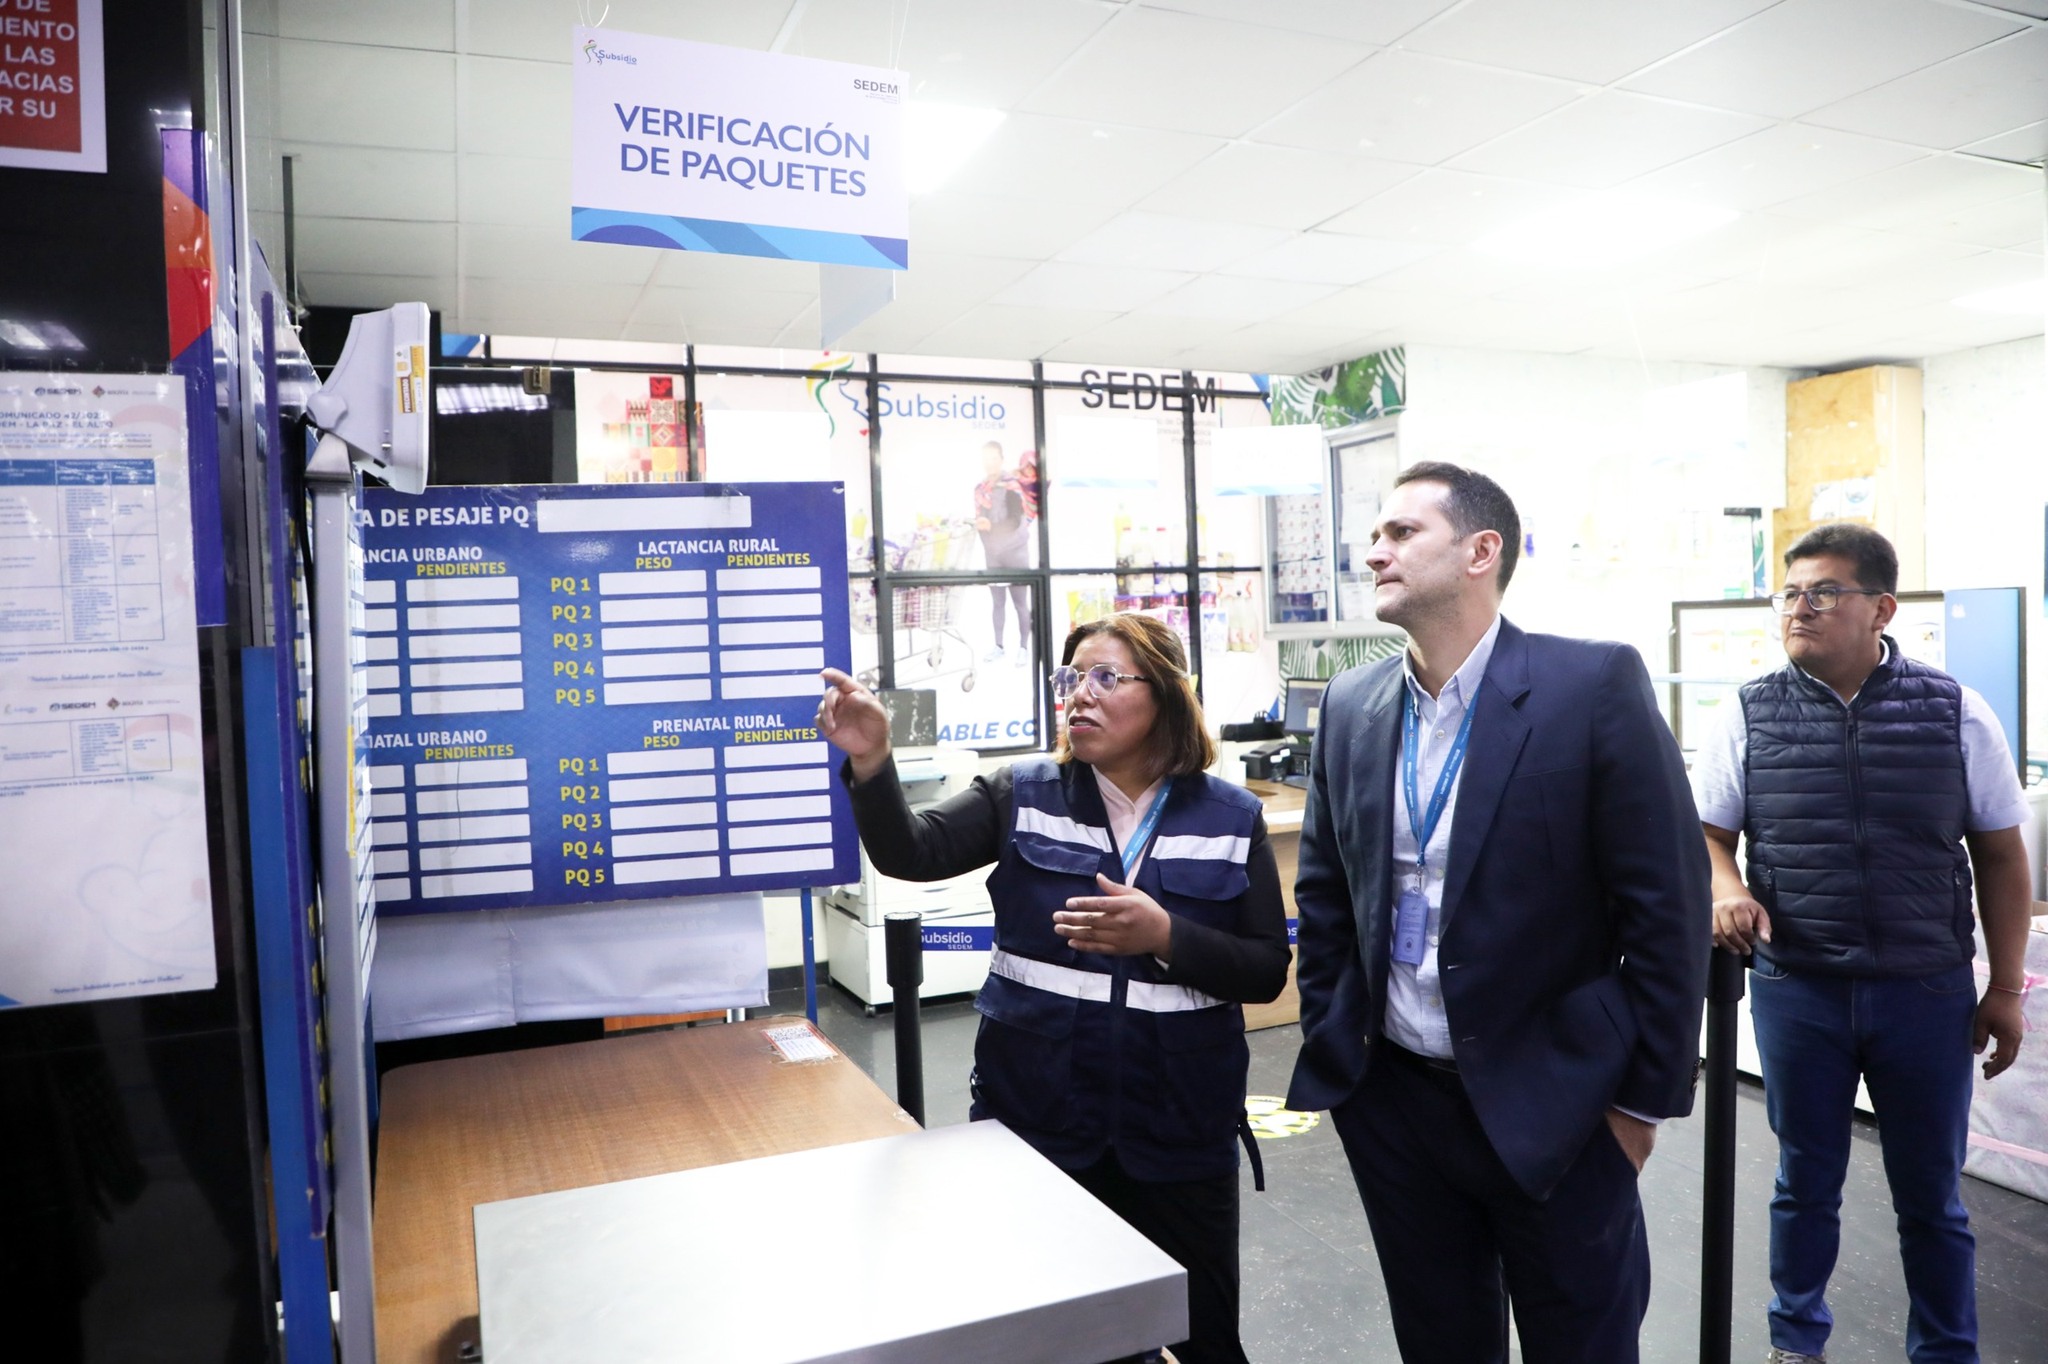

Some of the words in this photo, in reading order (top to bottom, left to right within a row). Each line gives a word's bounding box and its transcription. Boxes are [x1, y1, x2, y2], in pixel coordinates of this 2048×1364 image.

[6, 44, 56, 66] LAS
[599, 50, 637, 63] Subsidio
[854, 79, 898, 95] SEDEM
[22, 99, 56, 119] SU
[613, 103, 871, 161] VERIFICACIÓN
[620, 143, 670, 176] DE
[681, 150, 867, 198] PAQUETES
[1081, 369, 1216, 413] SEDEM
[865, 383, 1005, 421] Subsidio
[381, 508, 410, 527] DE
[416, 506, 493, 526] PESAJE
[499, 506, 530, 528] PQ
[412, 546, 483, 562] URBANO
[638, 539, 725, 555] LACTANCIA
[729, 538, 780, 553] RURAL
[417, 561, 506, 576] PENDIENTES
[636, 557, 672, 570] PESO
[727, 553, 811, 567] PENDIENTES
[551, 577, 576, 595] PQ
[581, 578, 591, 591] 1
[552, 605, 577, 623] PQ
[581, 605, 592, 619] 2
[553, 633, 578, 651] PQ
[582, 633, 593, 648] 3
[553, 660, 578, 679] PQ
[583, 661, 595, 676] 4
[556, 689, 581, 706] PQ
[585, 689, 596, 704] 5
[653, 717, 731, 733] PRENATAL
[734, 714, 785, 729] RURAL
[937, 722, 1000, 742] ABLE
[417, 730, 487, 746] URBANO
[644, 735, 680, 748] PESO
[735, 728, 818, 743] PENDIENTES
[425, 744, 514, 760] PENDIENTES
[559, 758, 584, 776] PQ
[589, 758, 599, 772] 1
[561, 785, 585, 804] PQ
[590, 786, 600, 799] 2
[562, 813, 587, 831] PQ
[591, 814, 602, 828] 3
[563, 841, 588, 859] PQ
[593, 841, 604, 856] 4
[565, 869, 590, 887] PQ
[595, 869, 605, 883] 5
